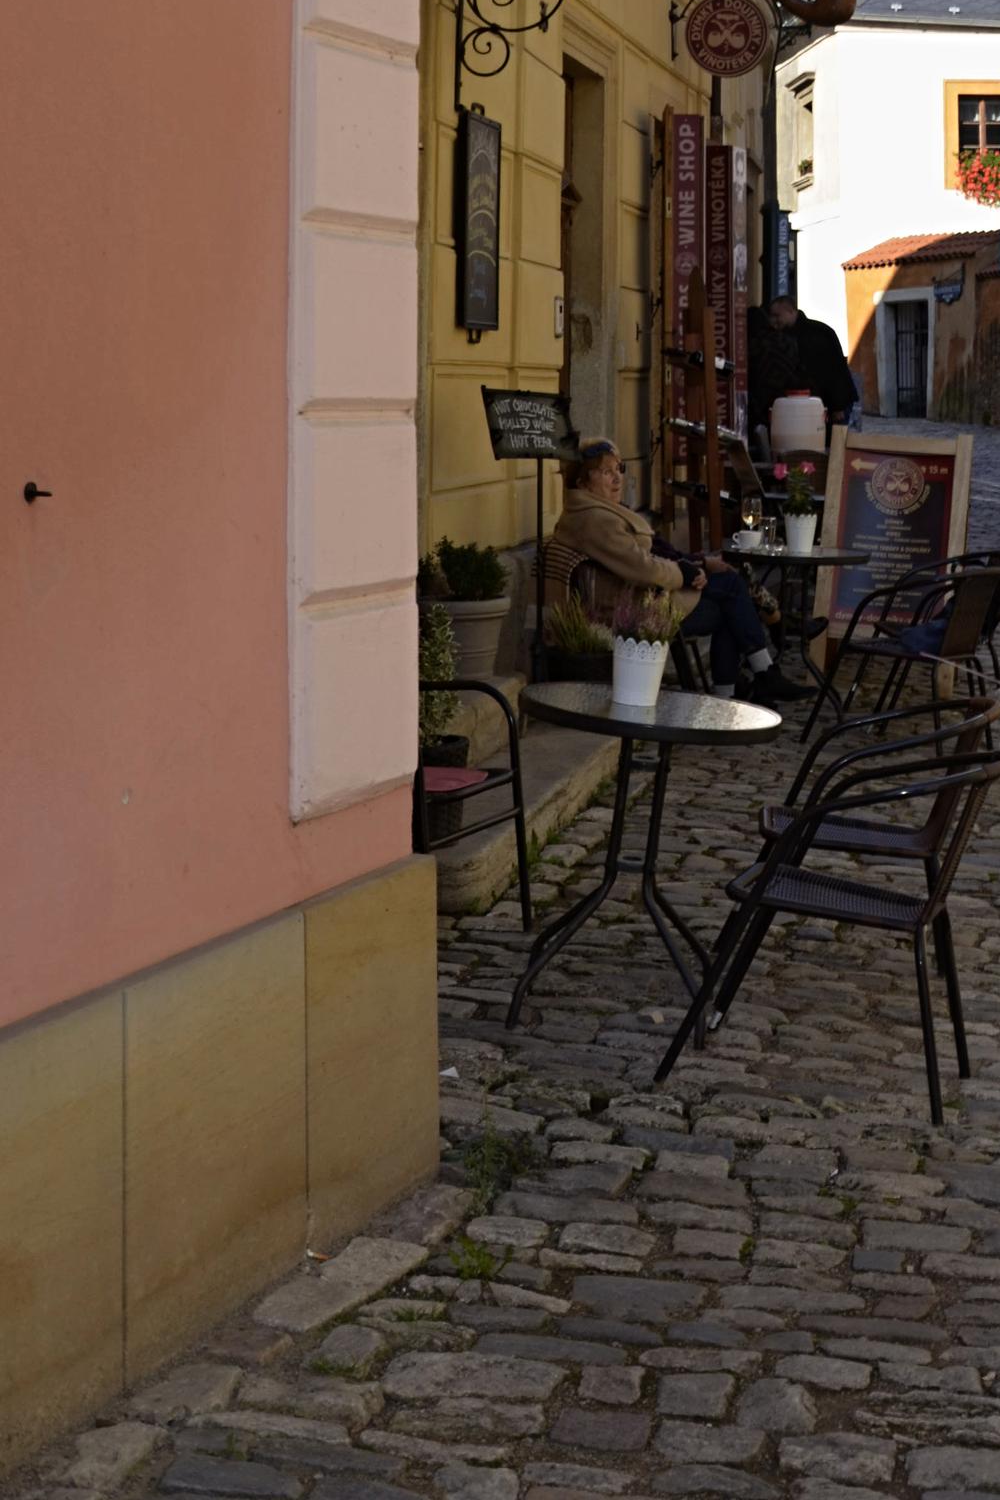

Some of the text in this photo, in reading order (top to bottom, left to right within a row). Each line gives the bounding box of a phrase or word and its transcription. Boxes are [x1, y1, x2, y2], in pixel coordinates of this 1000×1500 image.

[678, 123, 696, 246] WINE SHOP
[708, 155, 727, 243] VINOTÉKA
[494, 398, 558, 420] HOT CHOCOLATE
[509, 433, 529, 449] HOT
